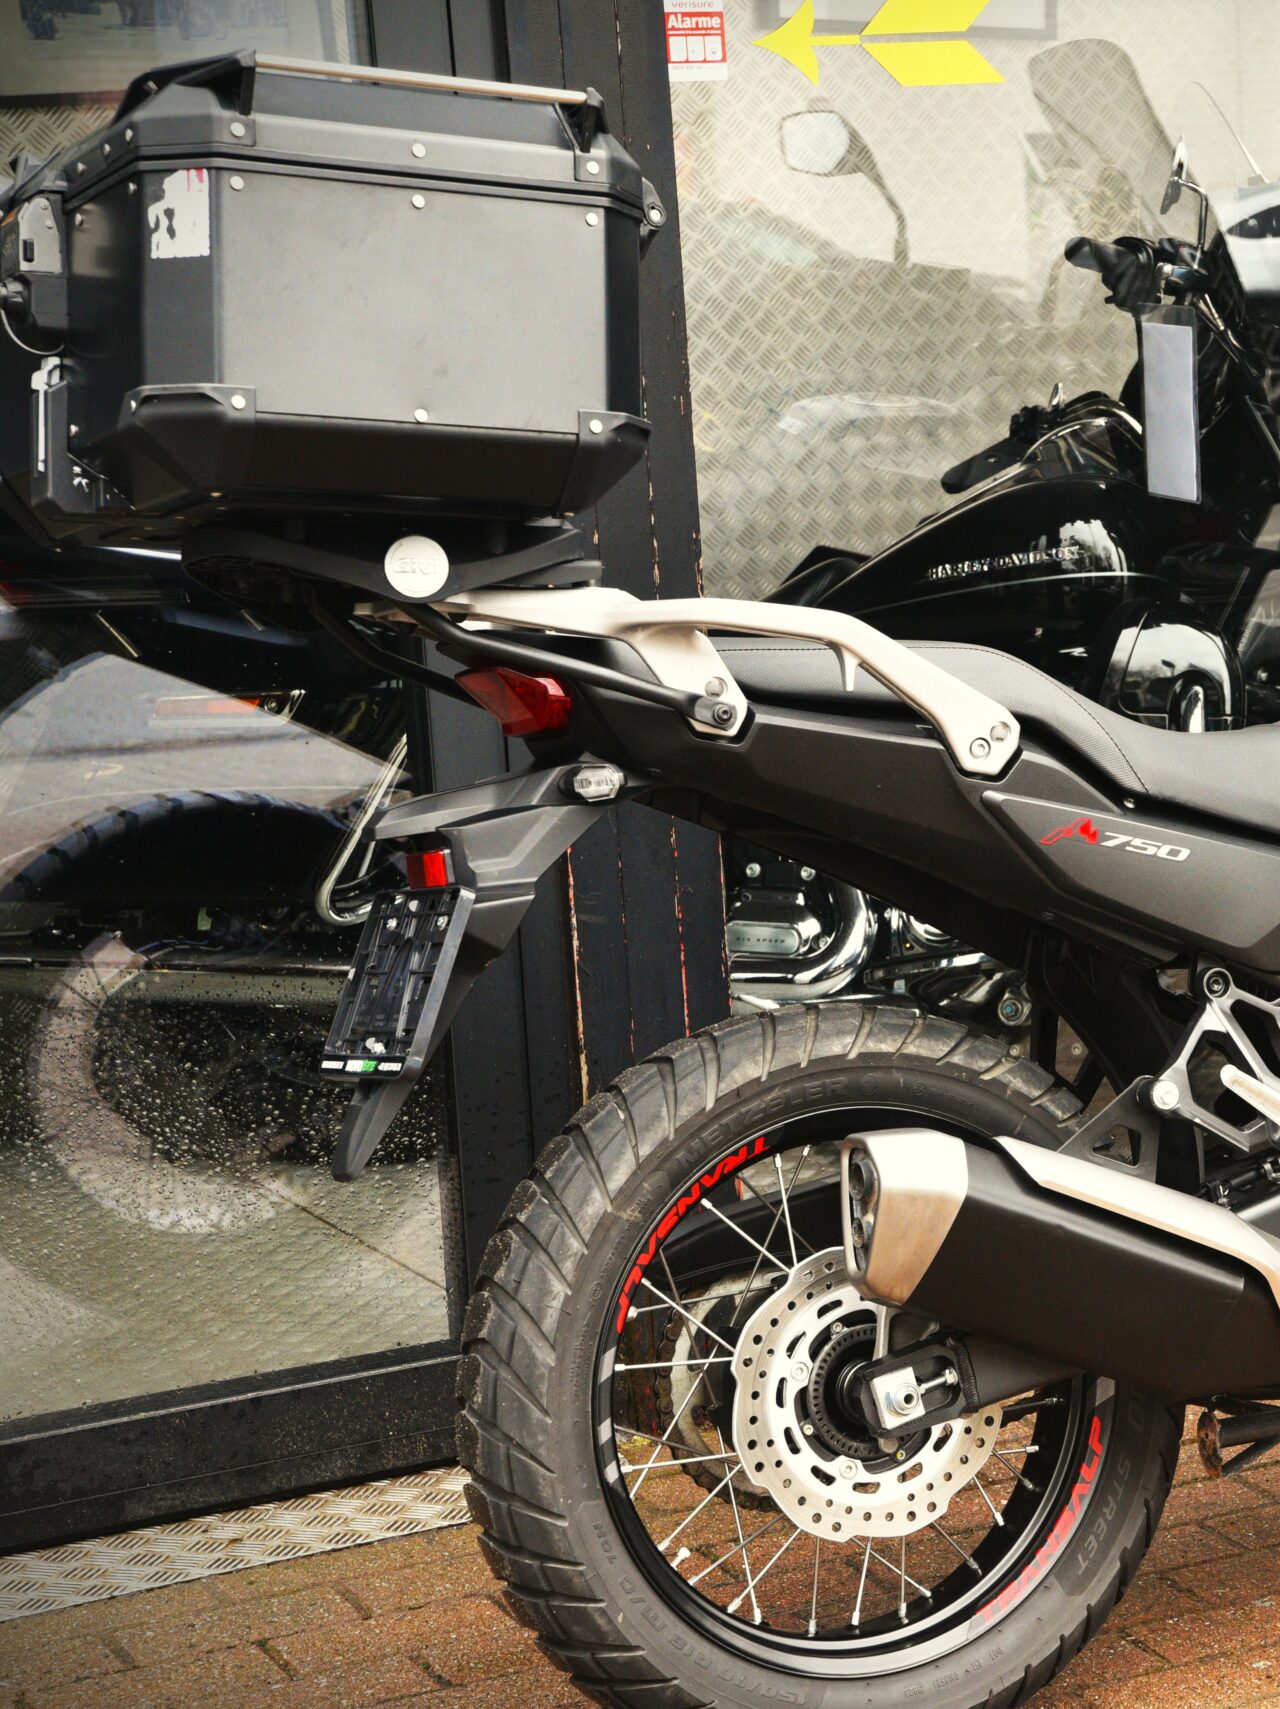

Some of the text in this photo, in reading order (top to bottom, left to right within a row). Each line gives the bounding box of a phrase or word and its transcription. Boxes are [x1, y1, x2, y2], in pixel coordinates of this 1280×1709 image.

[667, 12, 721, 29] Alarme
[1100, 831, 1191, 862] 750
[675, 1074, 849, 1170] METZELER
[616, 1136, 770, 1334] TRANSALP
[975, 1416, 1104, 1625] TRANSALP
[1077, 1452, 1131, 1576] STREET
